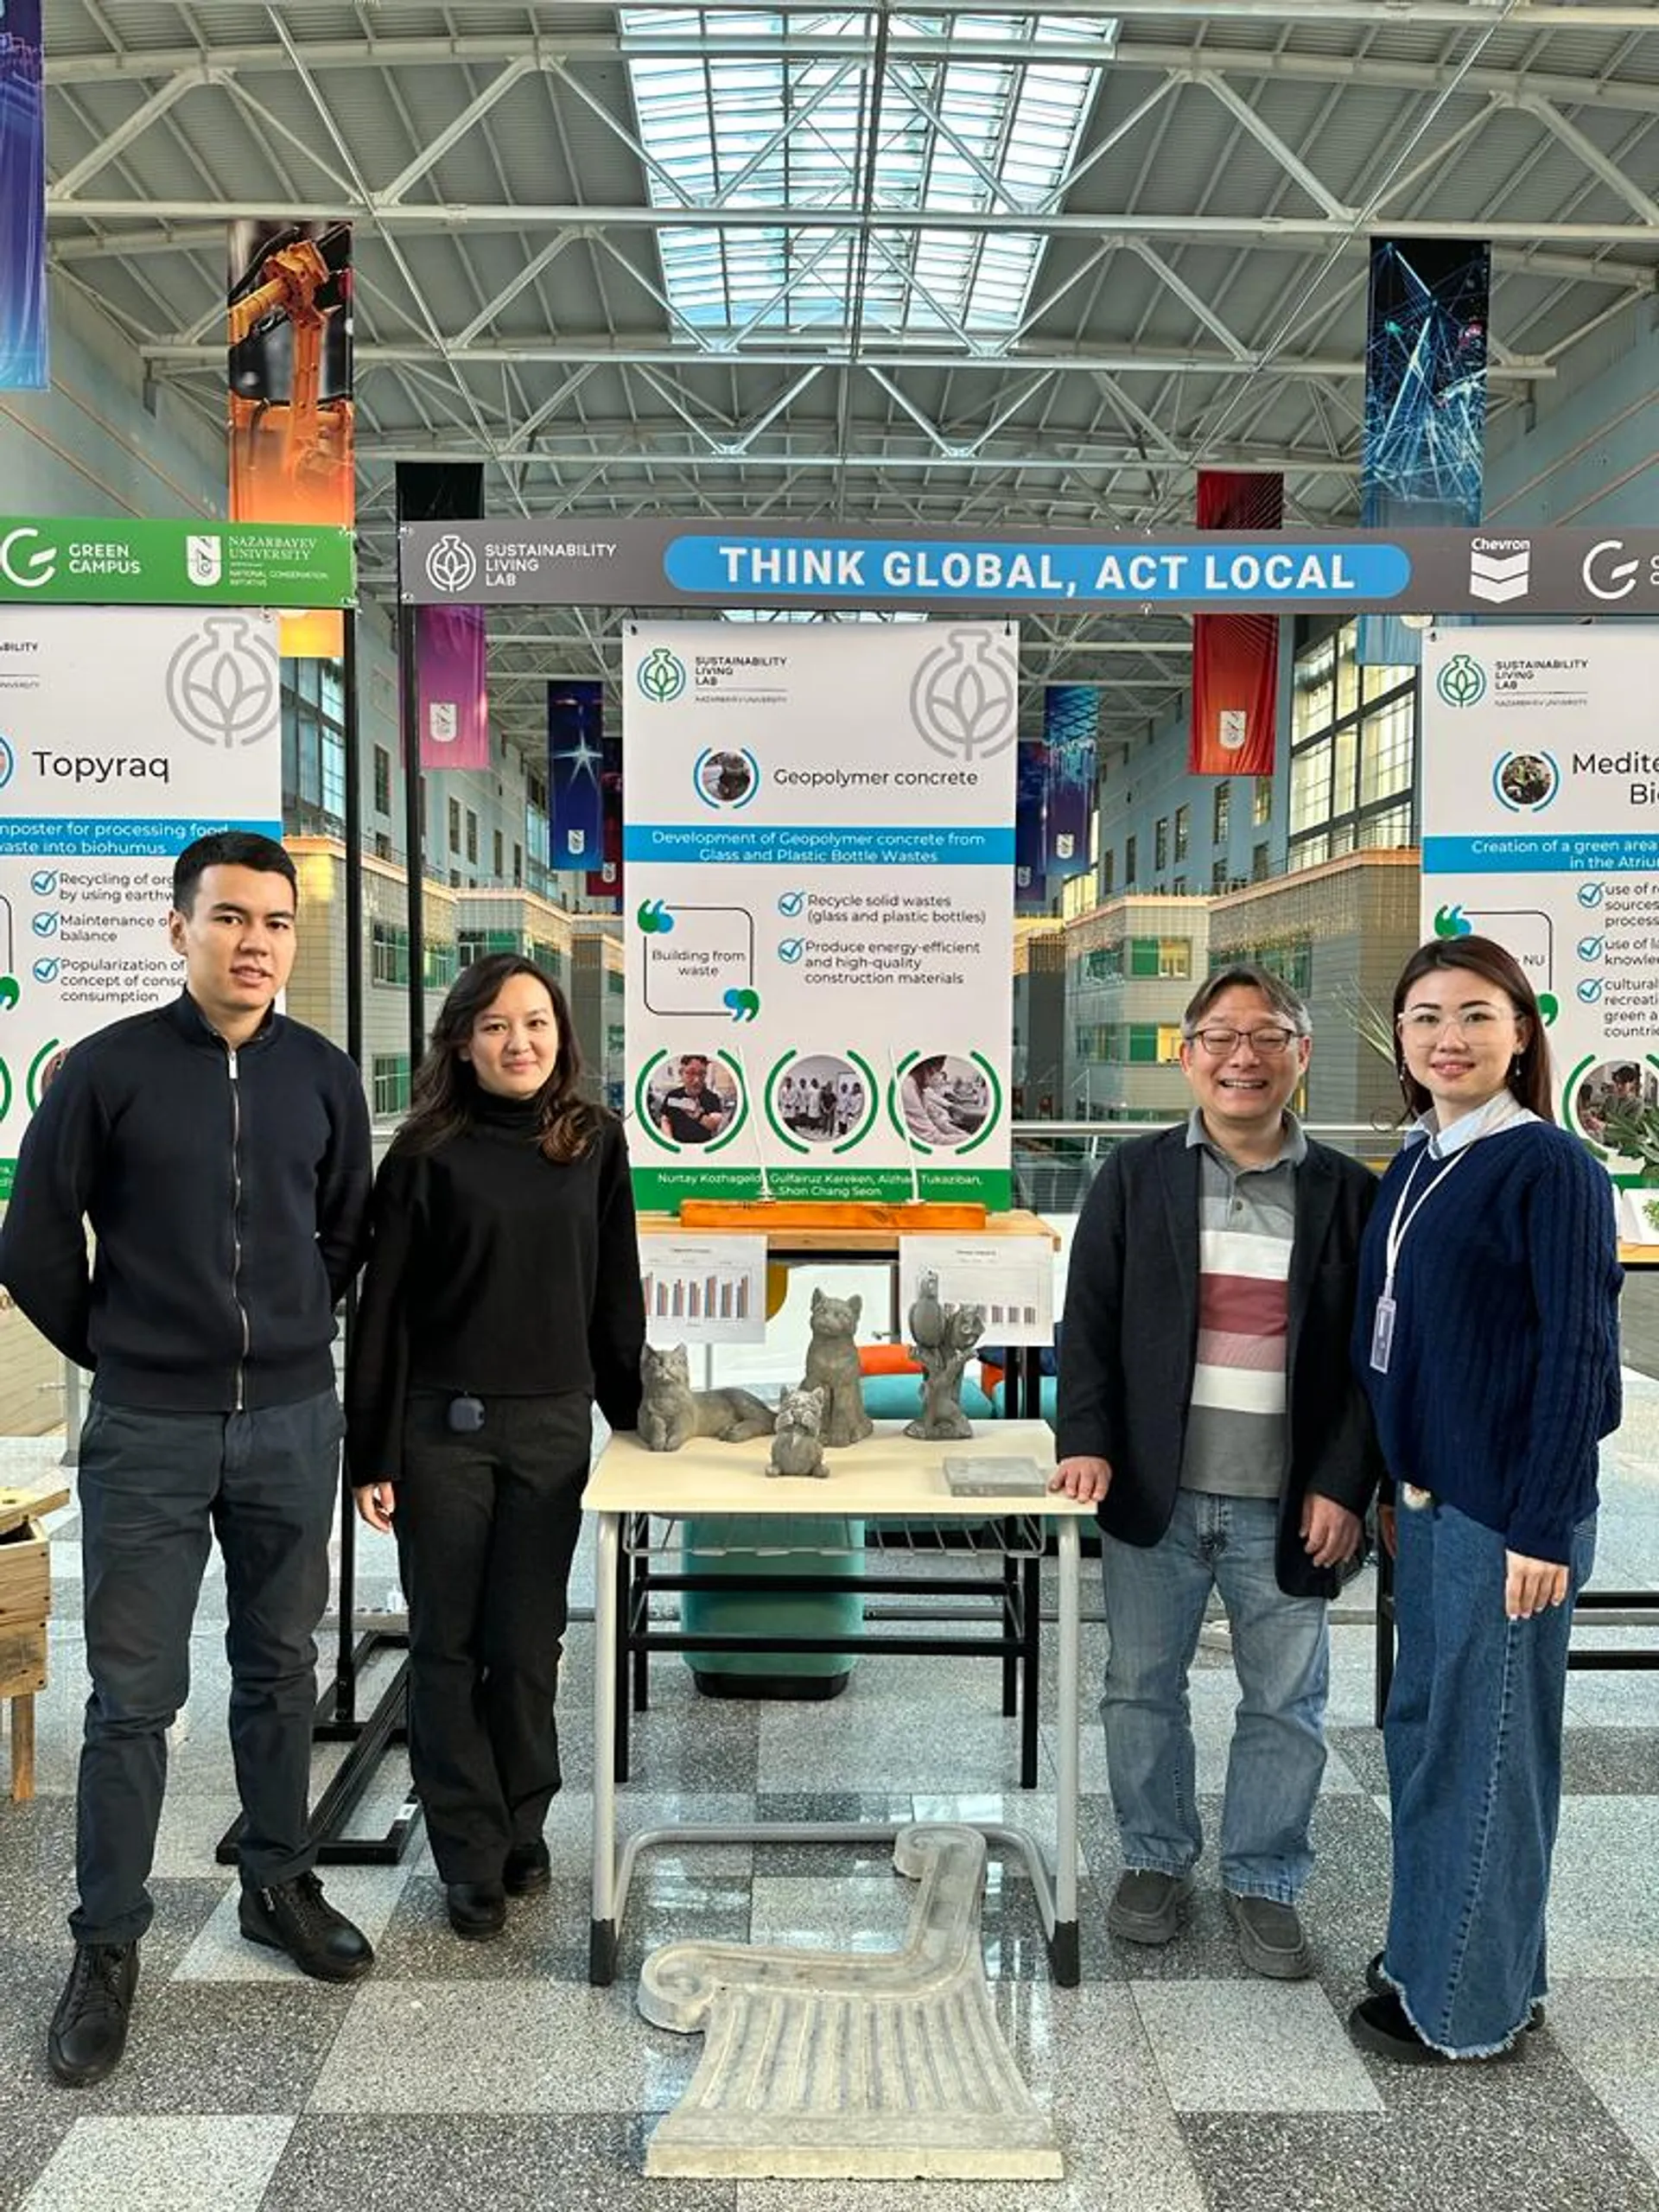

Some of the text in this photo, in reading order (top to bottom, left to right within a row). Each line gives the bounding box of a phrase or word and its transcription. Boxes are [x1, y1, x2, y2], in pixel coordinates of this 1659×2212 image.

[228, 536, 317, 549] NAZARBAYEV
[1471, 537, 1531, 550] Chevron
[68, 543, 130, 557] GREEN
[228, 549, 311, 561] UNIVERSITY
[485, 543, 617, 558] SUSTAINABILITY
[68, 560, 142, 575] CAMPUS
[485, 558, 539, 573] LIVING
[719, 546, 1356, 597] THINK GLOBAL, ACT LOCAL
[485, 573, 516, 588] LAB
[695, 657, 788, 667] SUSTAINABILITY
[1495, 659, 1590, 671] SUSTAINABILITY
[695, 667, 734, 676] LIVING
[1495, 671, 1535, 680] LIVING
[695, 676, 718, 686] LAB
[1495, 680, 1518, 690] LAB
[32, 751, 170, 784] Topyraq
[773, 767, 978, 788] Geopolymer concrete
[1630, 784, 1659, 805] Bi
[67, 821, 90, 836] for
[94, 823, 187, 840] processing
[190, 823, 229, 838] food
[652, 831, 986, 848] Development of Geopolymer concrete from
[0, 841, 168, 855] aste into biohumus
[1471, 839, 1659, 855] Creation of a green area
[699, 849, 938, 863] Glass and Plastic Bottle Wastes
[1570, 856, 1585, 869] in
[1587, 855, 1615, 869] the
[60, 873, 130, 888] Recycling
[134, 872, 149, 885] of
[60, 888, 77, 903] by
[81, 889, 121, 903] using
[1605, 884, 1630, 896] use
[1633, 882, 1649, 896] of
[808, 894, 951, 909] Recycle solid wastes
[1605, 899, 1659, 912] sources
[60, 914, 154, 927] Maintenance
[807, 910, 987, 925] (glass and plastic bottles)
[60, 930, 118, 942] balance
[1605, 938, 1630, 950] use
[1633, 936, 1648, 950] of
[805, 940, 981, 957] Produce energy-efficient
[652, 950, 746, 964] Building from
[804, 956, 922, 971] and high-quality
[1522, 955, 1545, 967] NU
[60, 957, 185, 973] Popularization of
[677, 966, 719, 977] waste
[60, 975, 121, 989] concept
[123, 973, 139, 987] of
[804, 972, 964, 985] construction materials
[1605, 976, 1658, 991] cultural
[60, 991, 159, 1004] consumption
[1605, 993, 1658, 1006] recreati
[1604, 1010, 1646, 1024] green
[657, 1173, 697, 1186] Nurtay
[699, 1173, 762, 1186] Kozhageld
[877, 1173, 914, 1185] Aizha
[778, 1185, 809, 1197] Shon
[810, 1185, 850, 1199] Chang
[852, 1185, 882, 1198] Seon
